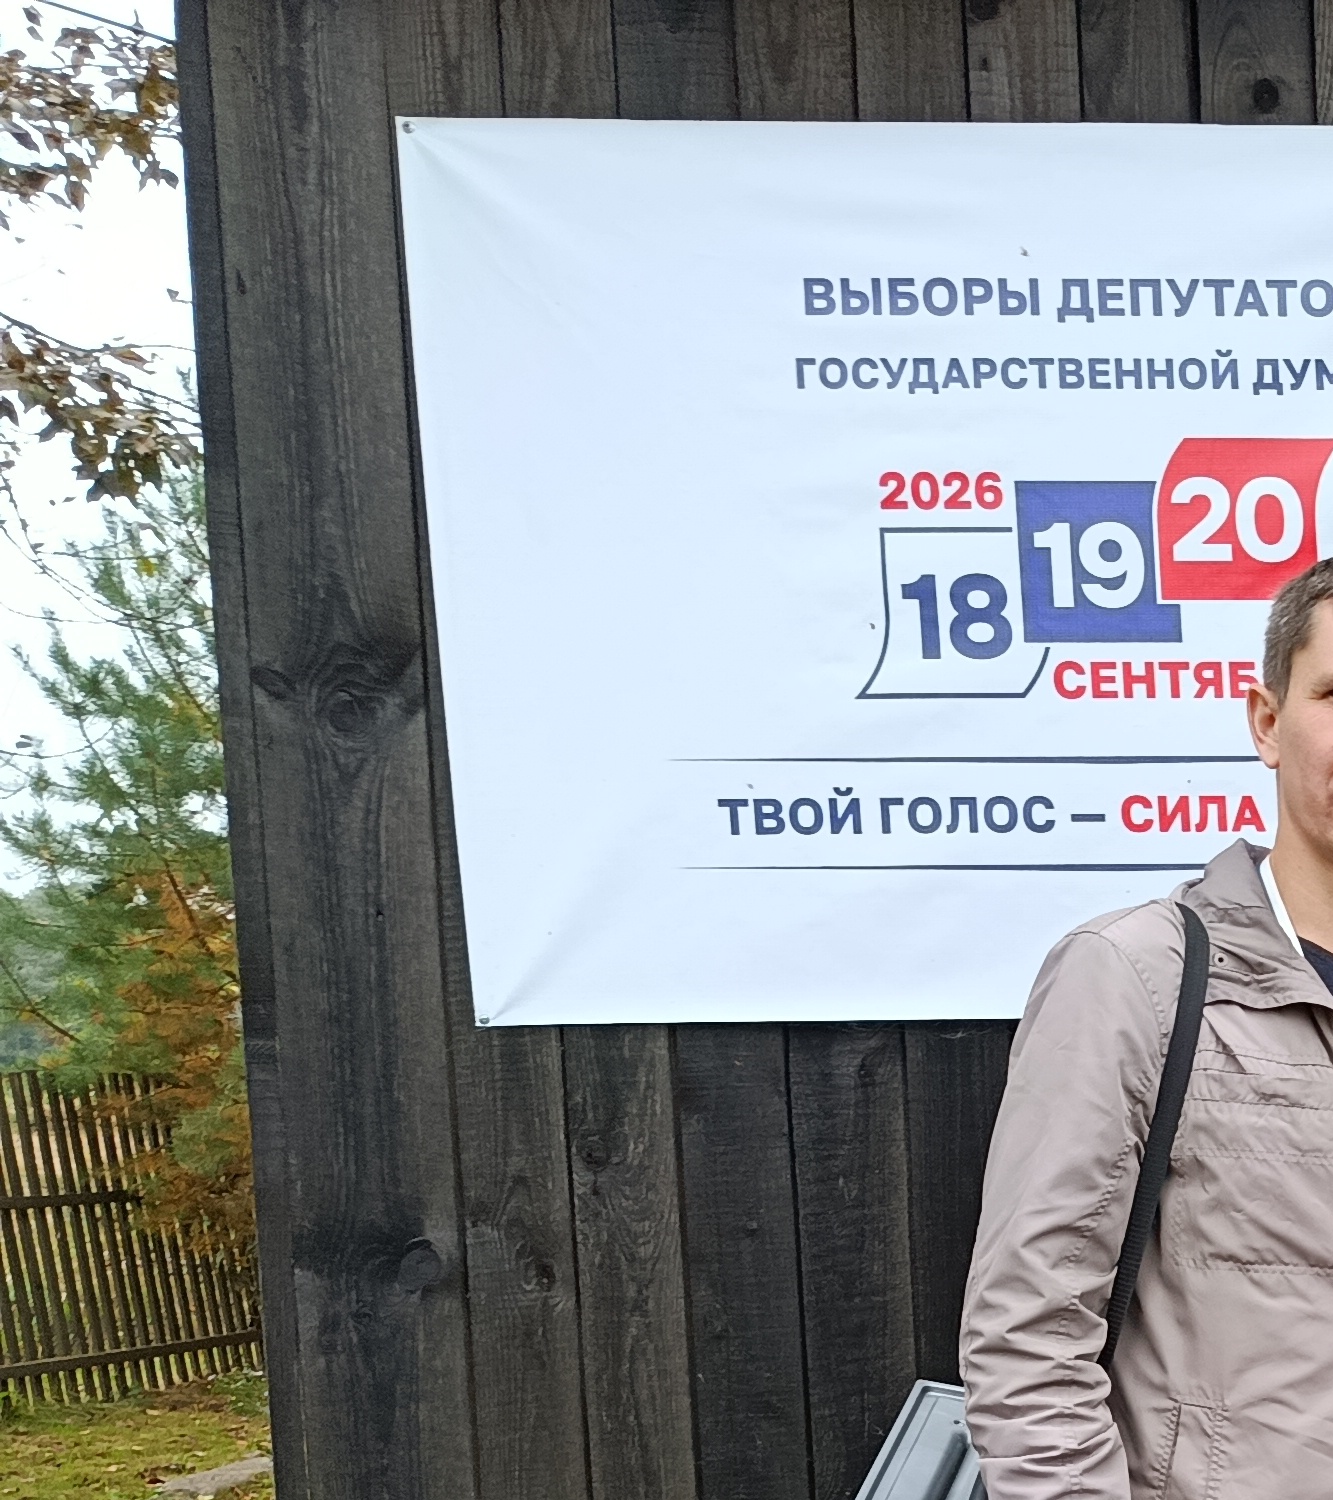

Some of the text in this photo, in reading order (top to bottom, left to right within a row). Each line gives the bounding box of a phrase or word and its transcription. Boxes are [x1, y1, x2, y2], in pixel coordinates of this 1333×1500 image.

[803, 277, 1040, 316] ВЫБОРЫ
[795, 349, 1239, 394] ГОСУДАРСТВЕННОЙ
[879, 472, 1002, 510] 2026
[1168, 475, 1305, 563] 20
[1033, 522, 1144, 608] 19
[901, 573, 1012, 659] 18
[1054, 661, 1255, 700] СЕНТЯБ
[718, 785, 863, 835] ТВОЙ
[879, 796, 1056, 834] ГОЛОС
[1121, 794, 1267, 833] СИЛА
